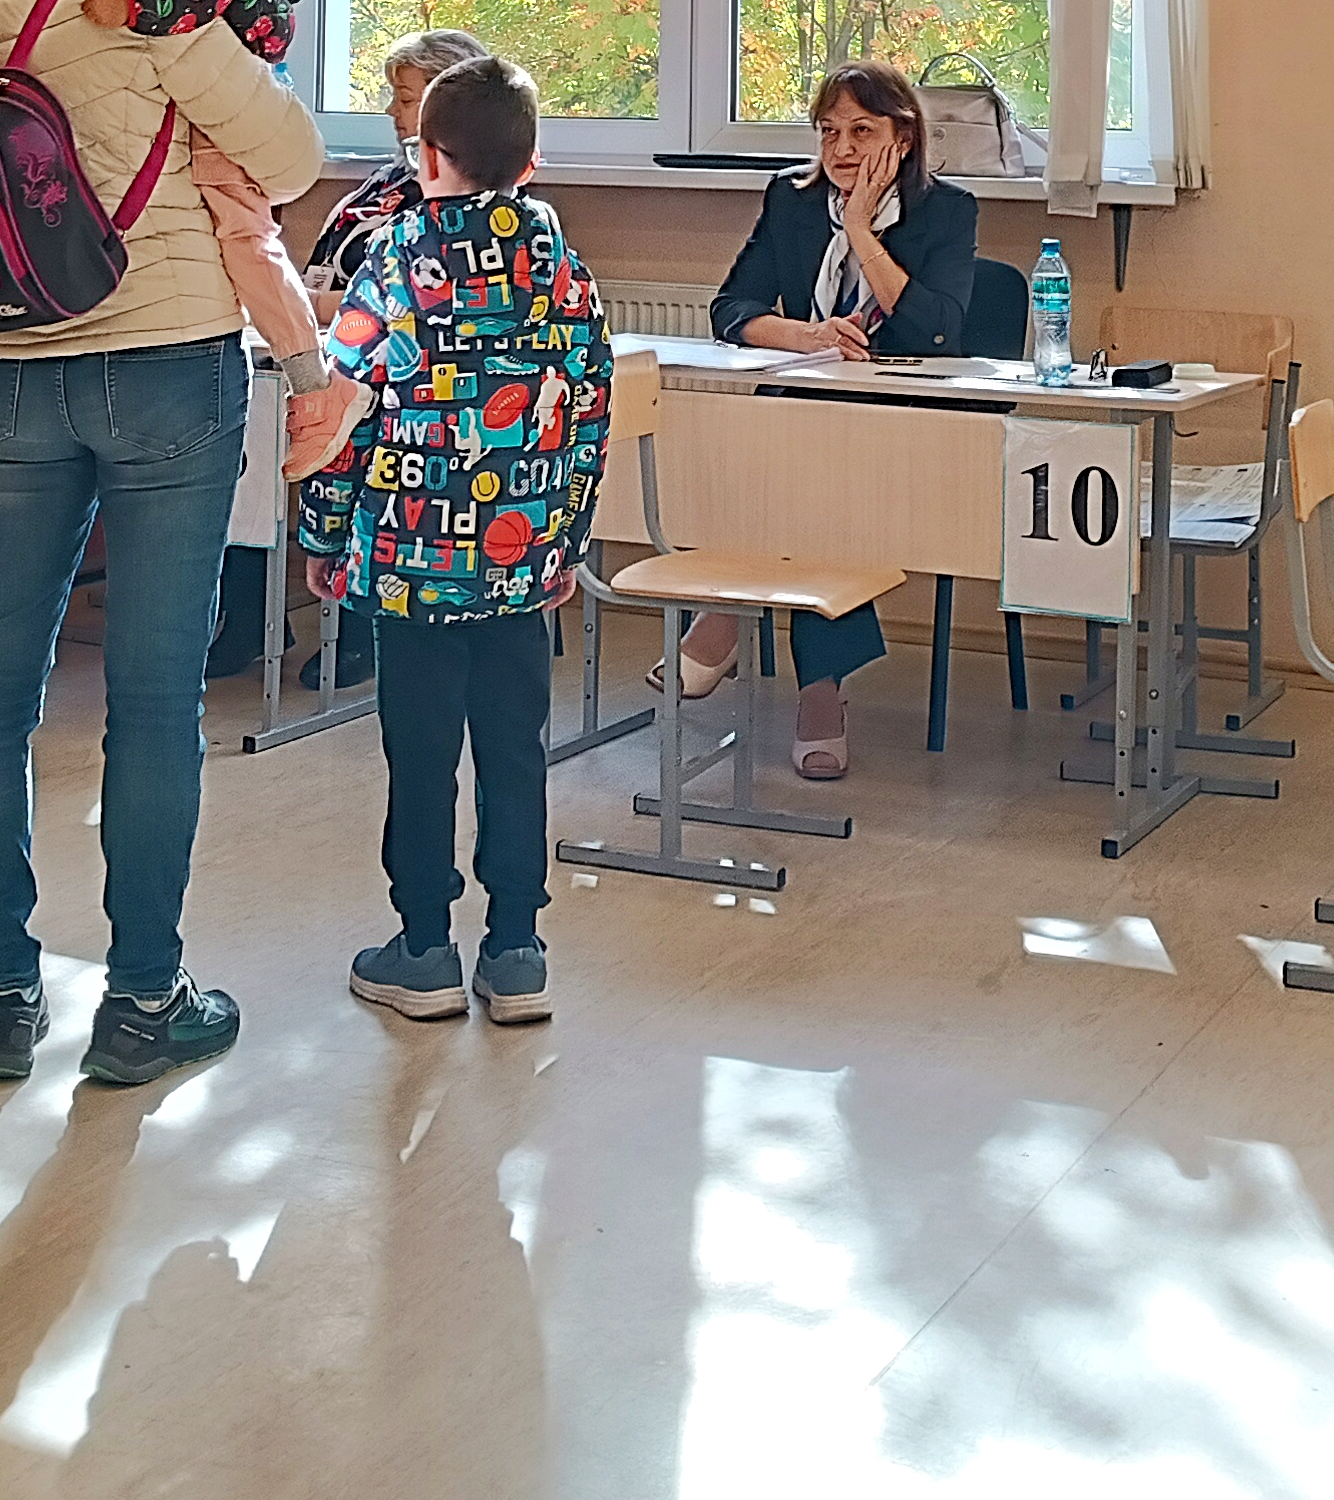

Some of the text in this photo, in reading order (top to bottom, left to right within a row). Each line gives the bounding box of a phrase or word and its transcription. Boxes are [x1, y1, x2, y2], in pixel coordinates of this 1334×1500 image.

[437, 330, 509, 352] LES
[377, 492, 477, 535] PLAY
[1021, 462, 1119, 547] 10
[373, 531, 477, 572] LET'S
